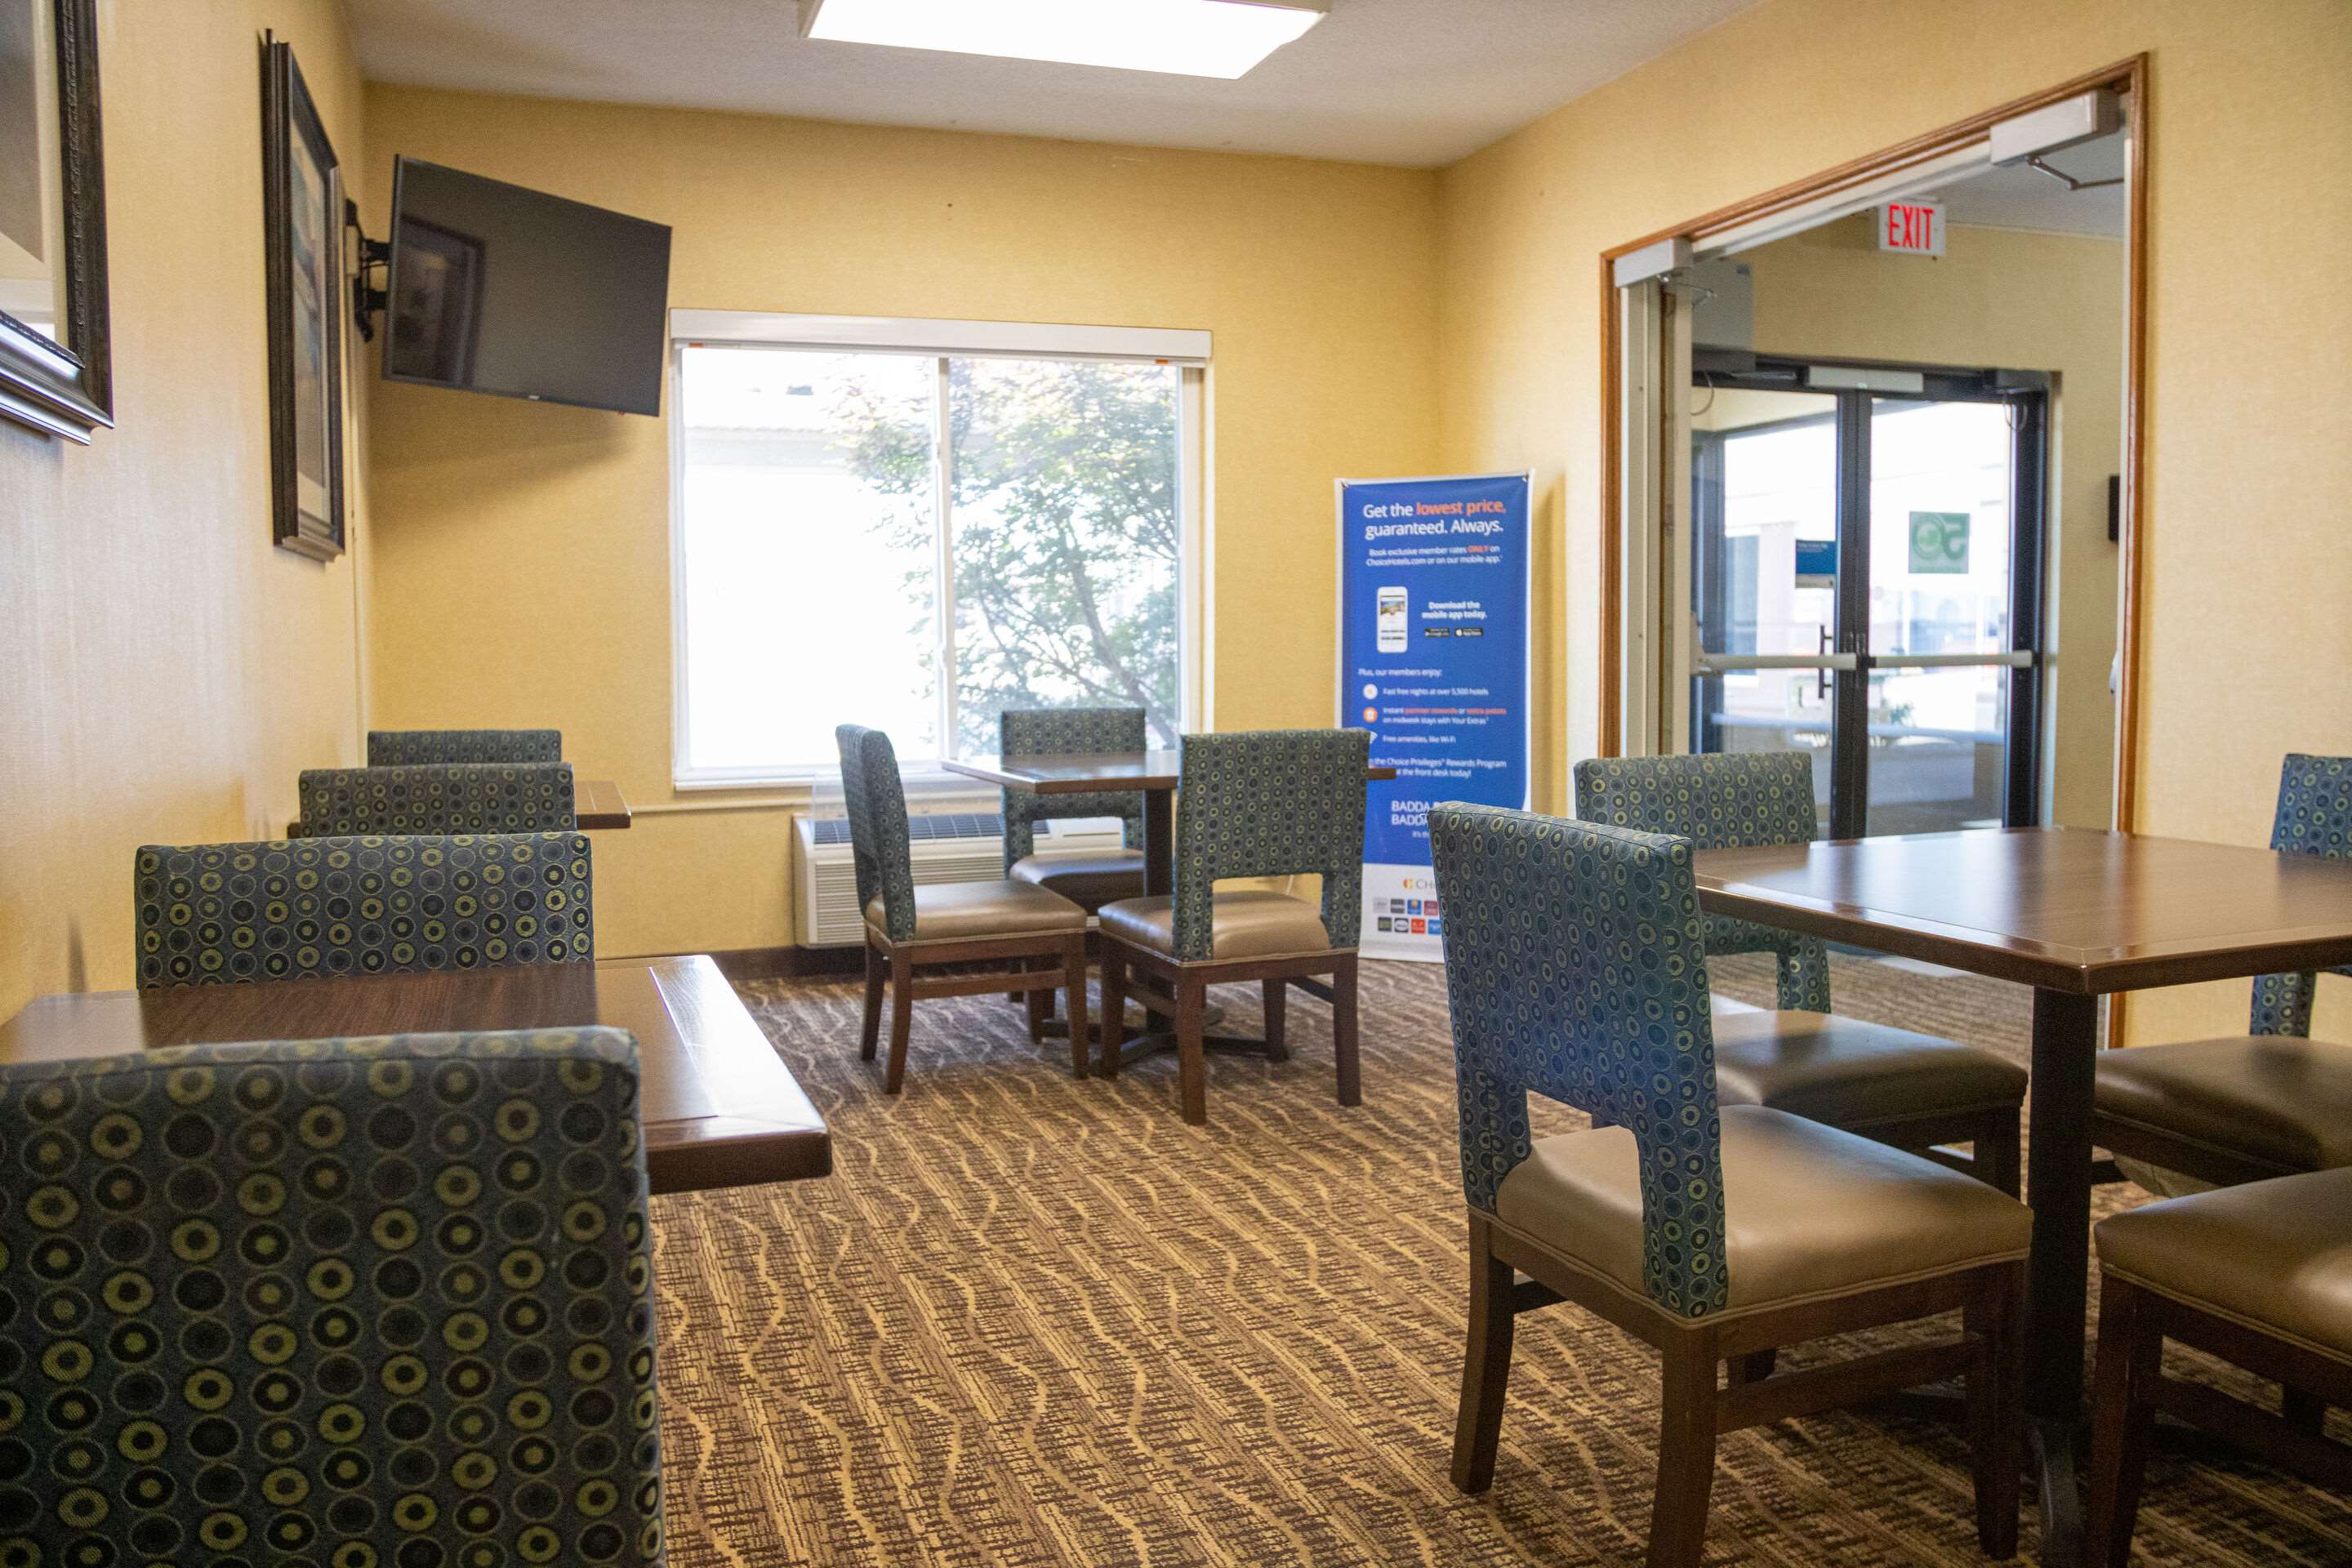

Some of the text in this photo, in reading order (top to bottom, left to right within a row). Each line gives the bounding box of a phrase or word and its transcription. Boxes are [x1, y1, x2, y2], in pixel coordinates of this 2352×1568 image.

[1888, 203, 1934, 249] EXIT
[1363, 504, 1388, 518] Get
[1390, 503, 1414, 517] the
[1416, 501, 1463, 515] lowest
[1365, 519, 1503, 540] guaranteed. Always.
[1369, 549, 1387, 557] Book
[1388, 547, 1418, 556] exclusive
[1419, 546, 1448, 555] member
[1427, 557, 1435, 565] or
[1459, 555, 1485, 564] mobile
[1428, 601, 1481, 610] Download the
[1422, 611, 1448, 620] mobile
[1449, 612, 1463, 621] app
[1358, 668, 1374, 677] Plus,
[1388, 668, 1421, 677] members
[1451, 716, 1467, 724] Your
[1374, 758, 1387, 766] the
[1387, 758, 1411, 766] Choice
[1446, 758, 1477, 768] Rewards
[1476, 759, 1508, 770] Program
[1391, 800, 1430, 813] BADDA
